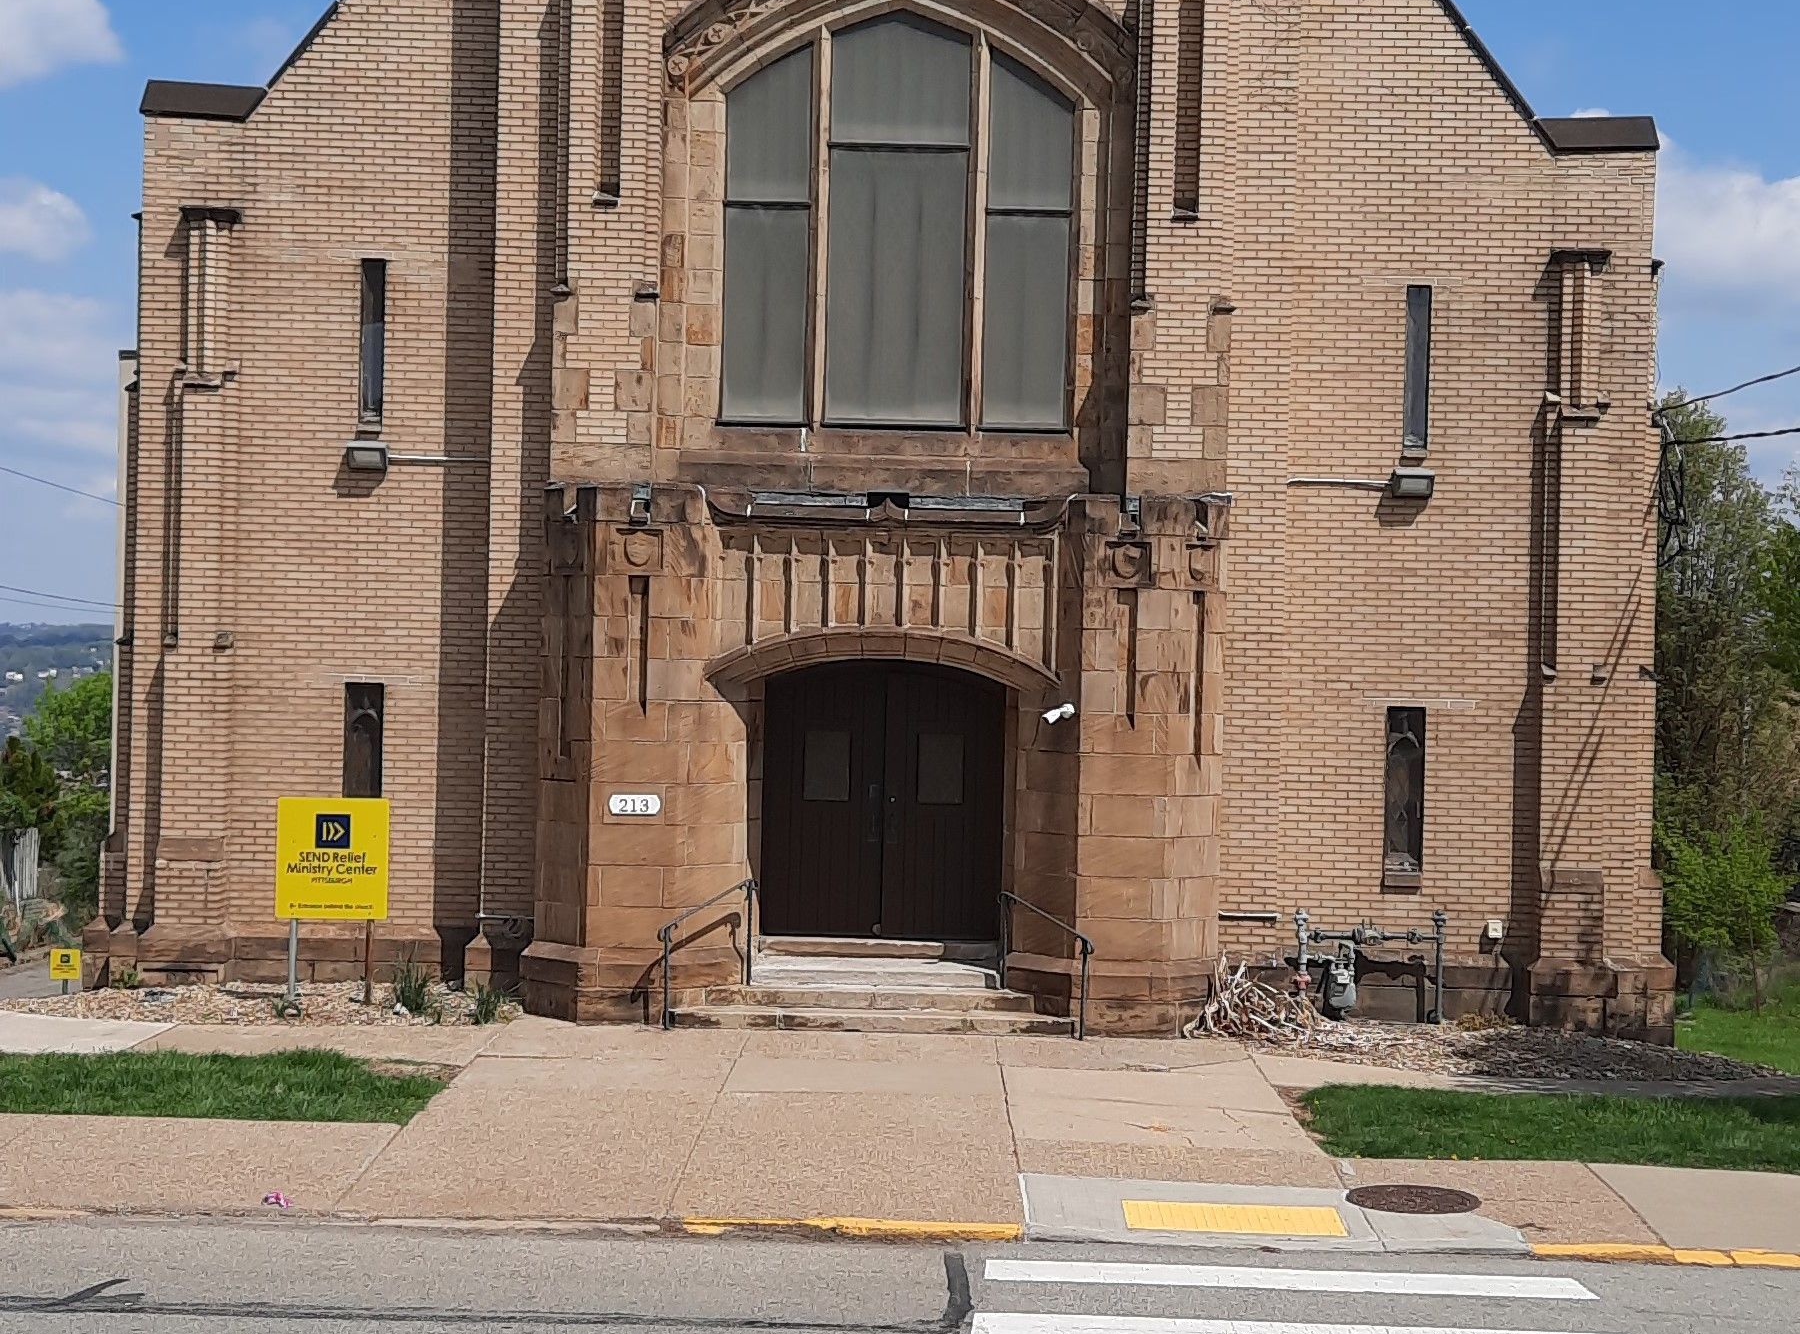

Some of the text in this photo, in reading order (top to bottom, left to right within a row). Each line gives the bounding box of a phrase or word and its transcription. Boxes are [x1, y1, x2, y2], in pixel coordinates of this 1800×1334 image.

[618, 798, 649, 813] 213
[298, 851, 366, 863] SEND Relief
[286, 862, 377, 876] Ministry Center
